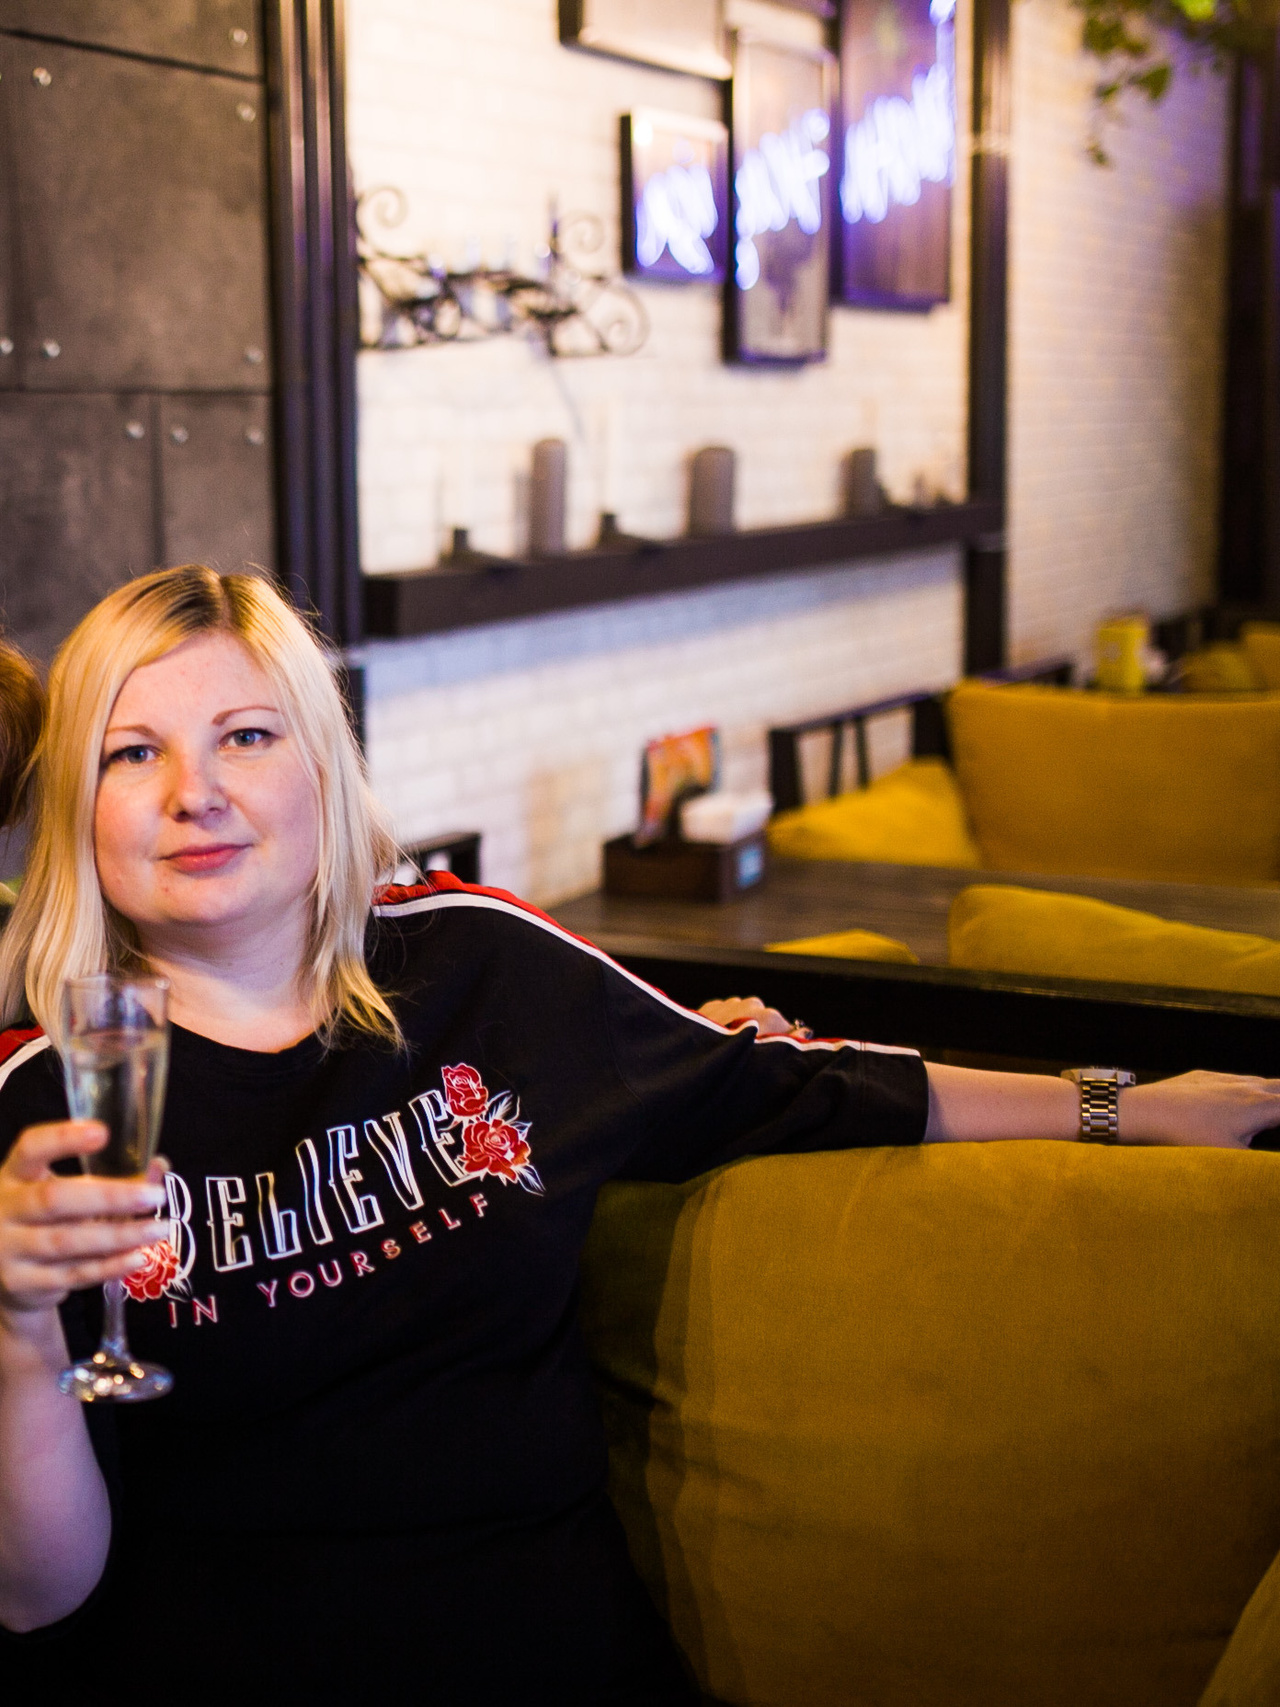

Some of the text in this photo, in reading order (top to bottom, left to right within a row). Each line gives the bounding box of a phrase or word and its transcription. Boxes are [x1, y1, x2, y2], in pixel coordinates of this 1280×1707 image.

[155, 1089, 477, 1280] BELIEVE
[168, 1193, 488, 1328] IN YOURSELF
